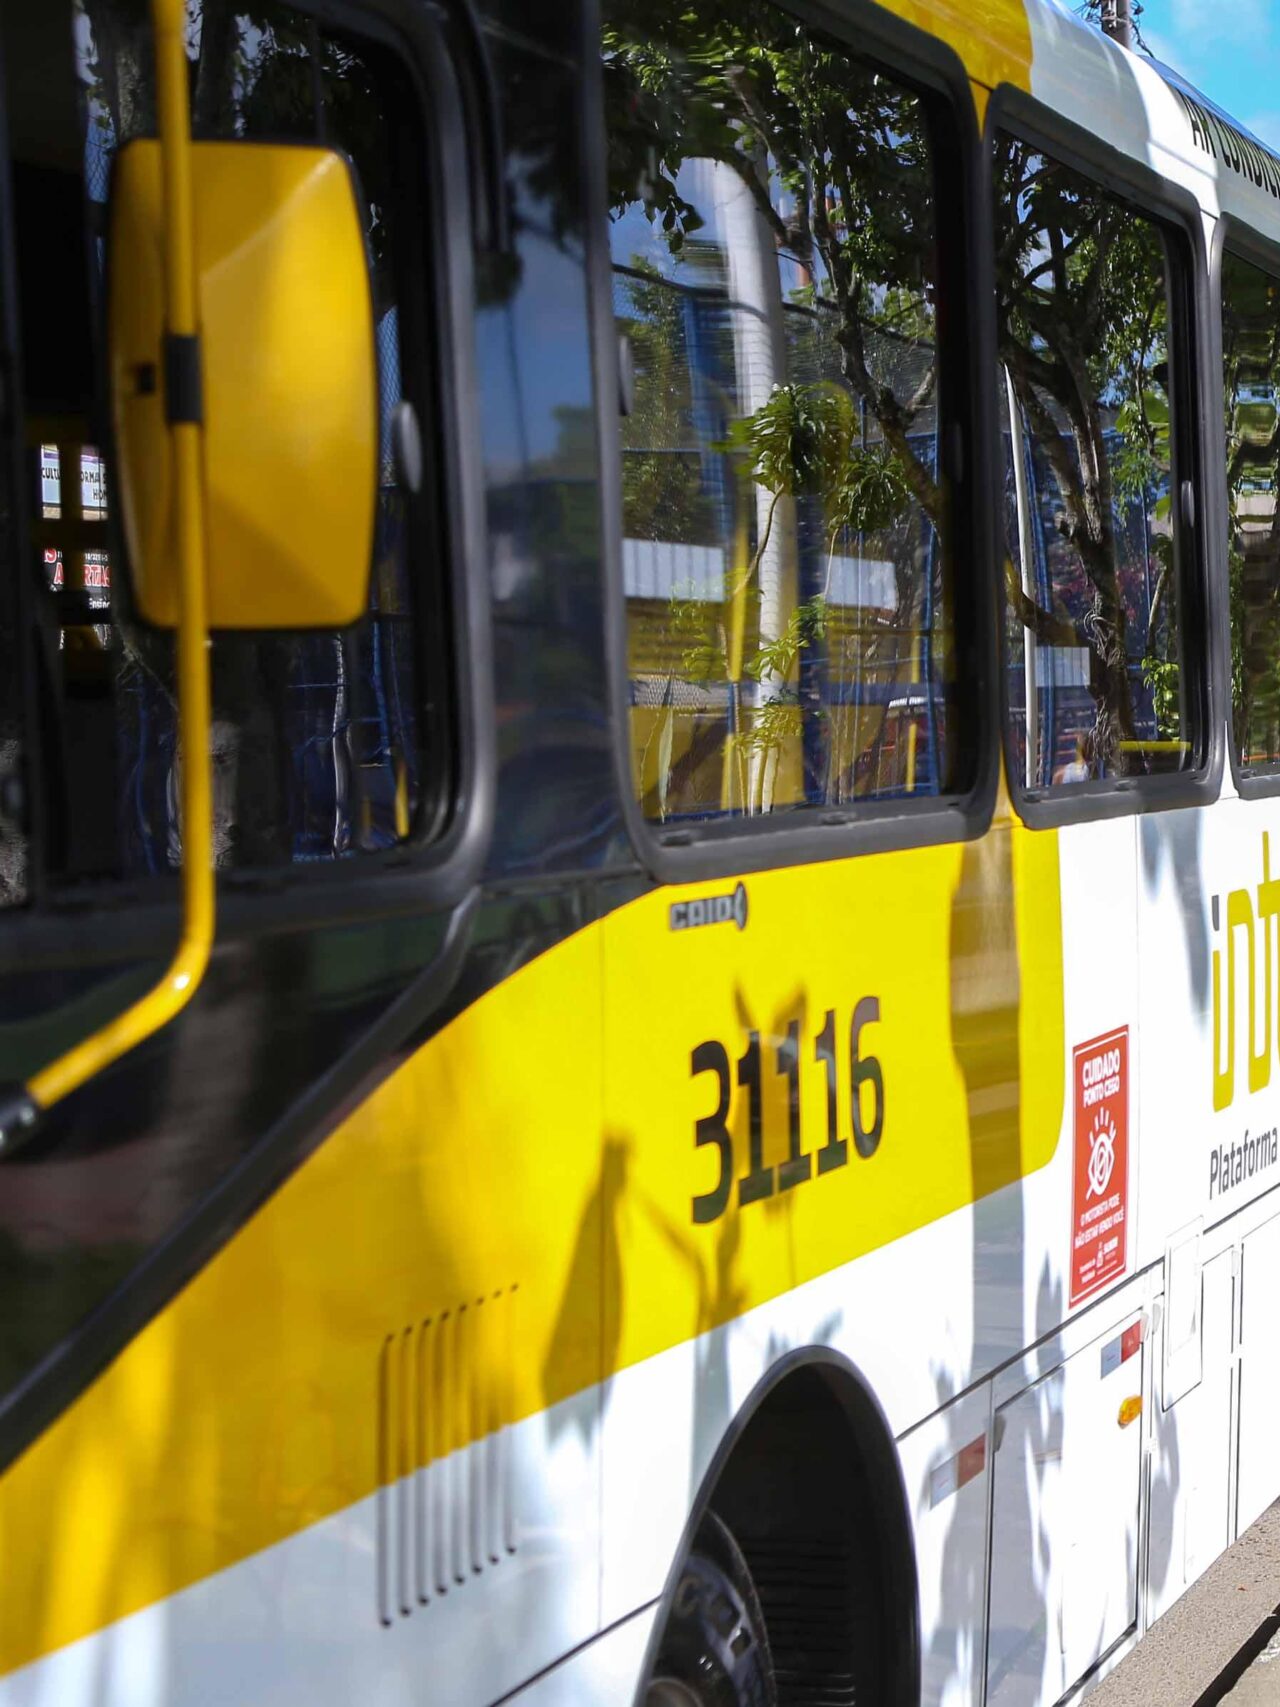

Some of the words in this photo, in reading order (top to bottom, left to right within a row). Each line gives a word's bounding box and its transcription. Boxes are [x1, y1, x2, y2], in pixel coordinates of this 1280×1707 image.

[1083, 1047, 1121, 1088] CUIDADO
[1083, 1082, 1105, 1108] PONTO
[691, 996, 885, 1225] 31116
[1209, 1127, 1279, 1201] Plataforma
